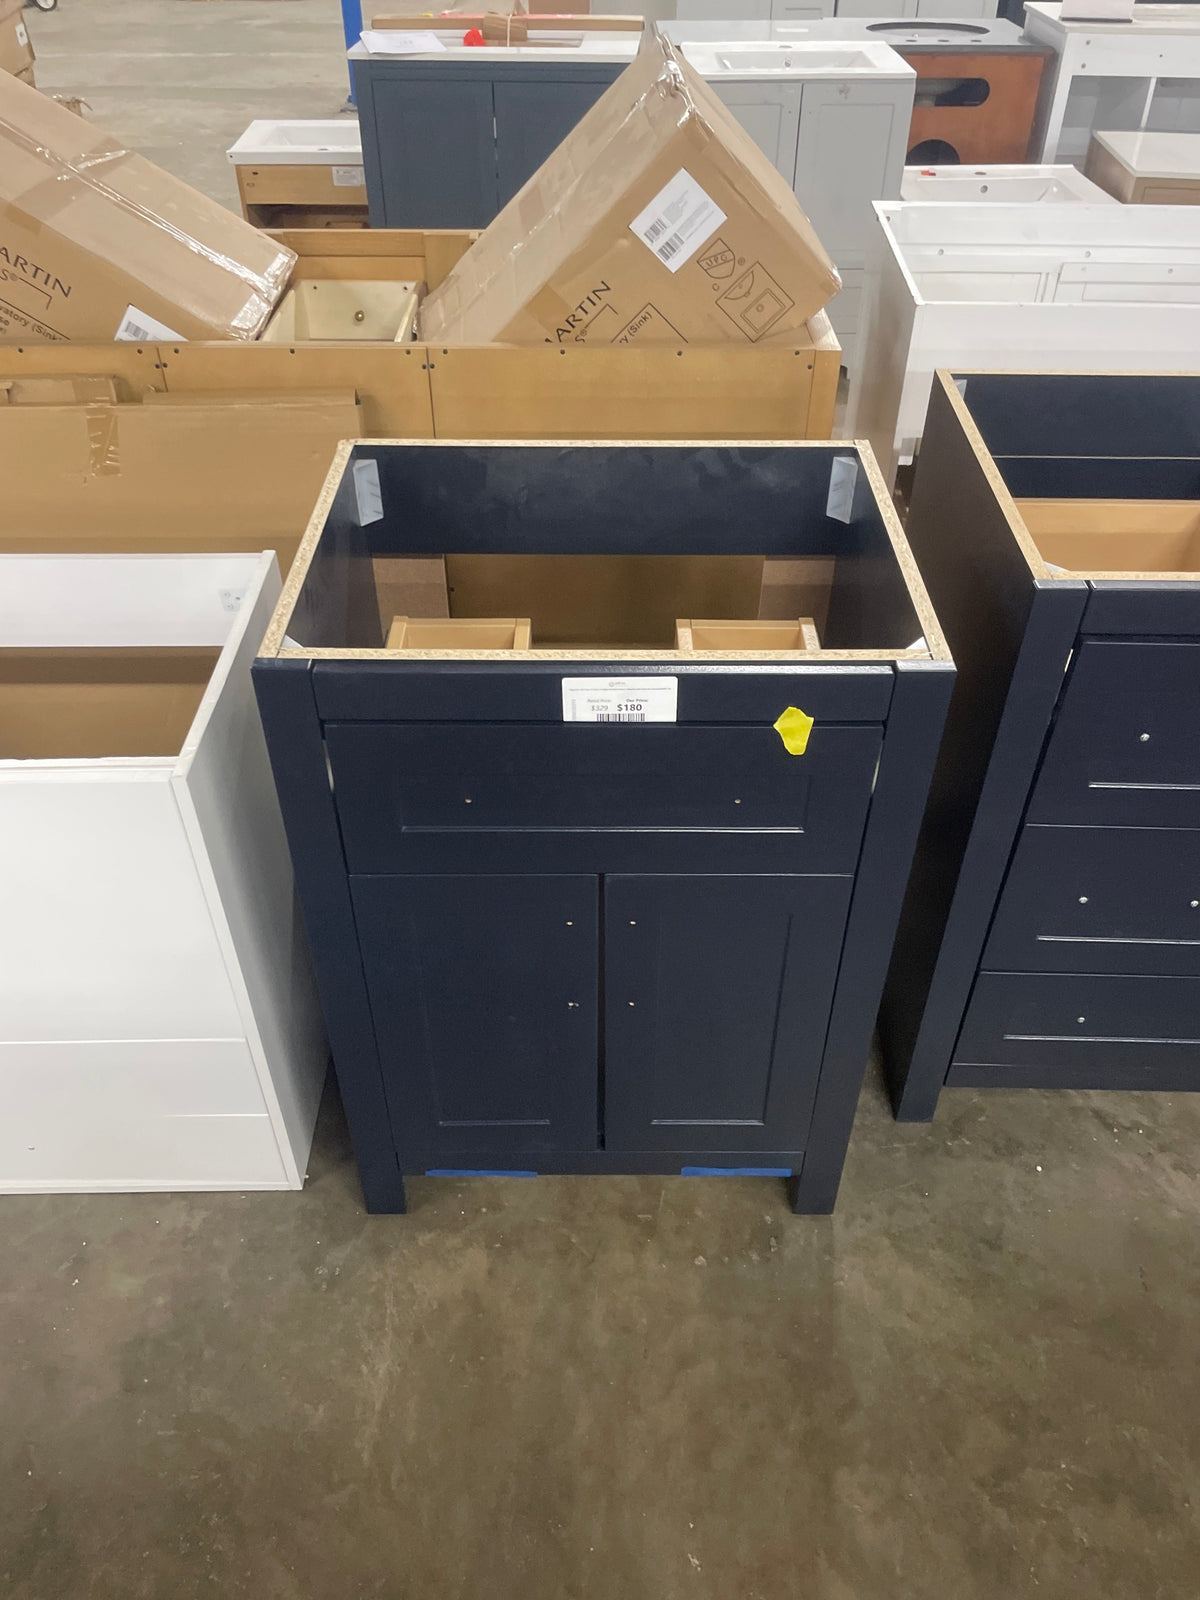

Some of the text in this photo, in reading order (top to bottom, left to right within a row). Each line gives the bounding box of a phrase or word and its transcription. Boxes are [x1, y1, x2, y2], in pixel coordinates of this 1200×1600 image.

[545, 280, 611, 343] ARTIN
[627, 311, 653, 337] (Sink)
[617, 703, 643, 712] $180
